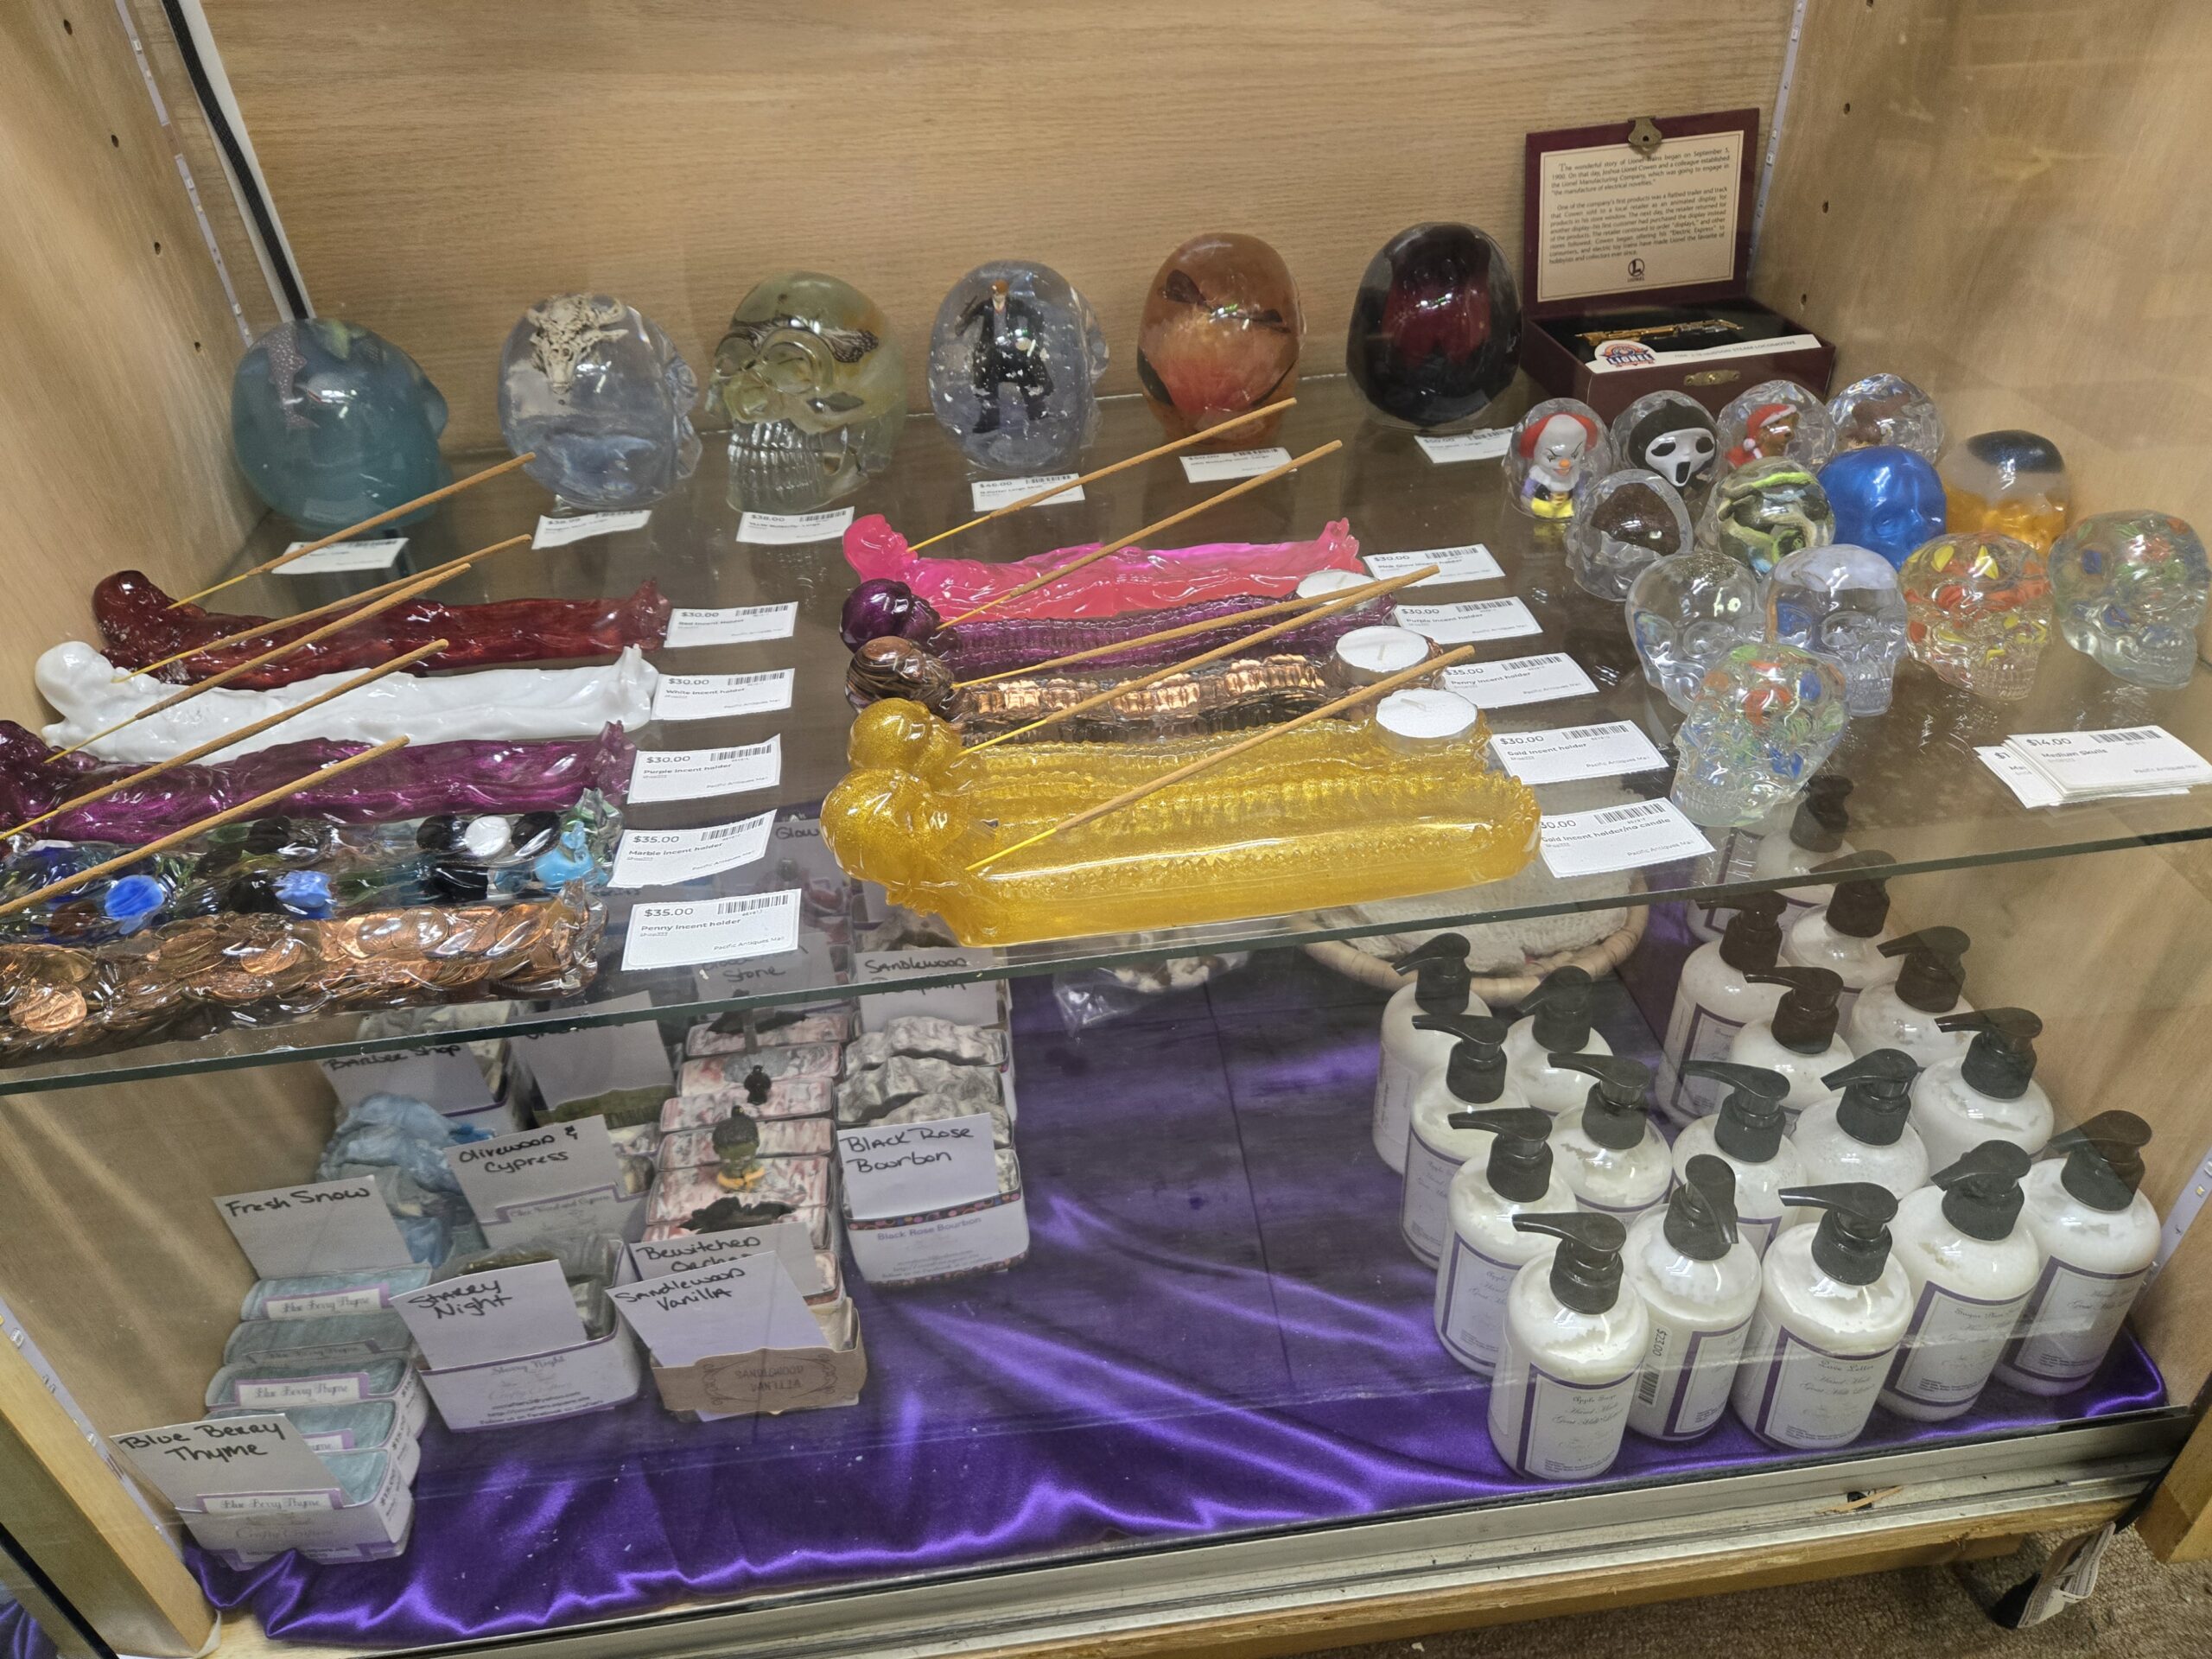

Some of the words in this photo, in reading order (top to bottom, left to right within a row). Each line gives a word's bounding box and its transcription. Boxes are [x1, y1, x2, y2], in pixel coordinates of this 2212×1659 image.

[1559, 162, 1572, 171] The
[1574, 162, 1602, 170] wonderful
[1694, 148, 1722, 156] September
[1700, 155, 1730, 163] established
[1580, 176, 1618, 185] Manufacturing
[1564, 186, 1596, 194] manufacture
[1607, 353, 1654, 365] LIONEL
[1505, 671, 1531, 680] holder
[1499, 735, 1544, 745] $30.00
[2026, 738, 2072, 747] $14.00
[646, 755, 690, 764] $30.00
[1607, 757, 1637, 766] Antiques
[1541, 819, 1577, 829] 30.00
[1594, 824, 1638, 837] holder/no
[1639, 818, 1671, 829] candle
[776, 826, 820, 840] Glow
[694, 842, 723, 851] holder
[1650, 842, 1680, 852] Antiques
[644, 907, 694, 918] $35.00
[709, 918, 741, 927] holder
[713, 942, 736, 950] Pacific
[738, 938, 770, 947] Antiques
[722, 965, 786, 982] Stone
[839, 1131, 911, 1153] Black
[906, 1127, 974, 1140] Rose
[459, 1135, 555, 1163] Olivewood
[485, 1151, 569, 1173] Cypress
[846, 1151, 951, 1173] Bourbon
[226, 1197, 290, 1217] Fresh
[290, 1187, 370, 1204] Snow
[877, 1230, 906, 1241] Black
[909, 1227, 935, 1236] Rose
[937, 1217, 982, 1231] Bourbon
[636, 1236, 761, 1261] Bewitched
[614, 1267, 746, 1304] Sandlewood
[434, 1294, 512, 1319] Night
[657, 1287, 734, 1312] Vanilla
[1652, 1328, 1669, 1357] $23.00
[255, 1387, 276, 1398] Blue
[283, 1385, 312, 1397] Berry
[315, 1383, 348, 1394] Thyme
[119, 1433, 191, 1449] Blue
[194, 1422, 286, 1440] Berry
[164, 1444, 268, 1463] Thyme
[221, 1499, 245, 1510] Blue
[251, 1499, 282, 1510] Berry
[285, 1497, 321, 1508] Thyme
